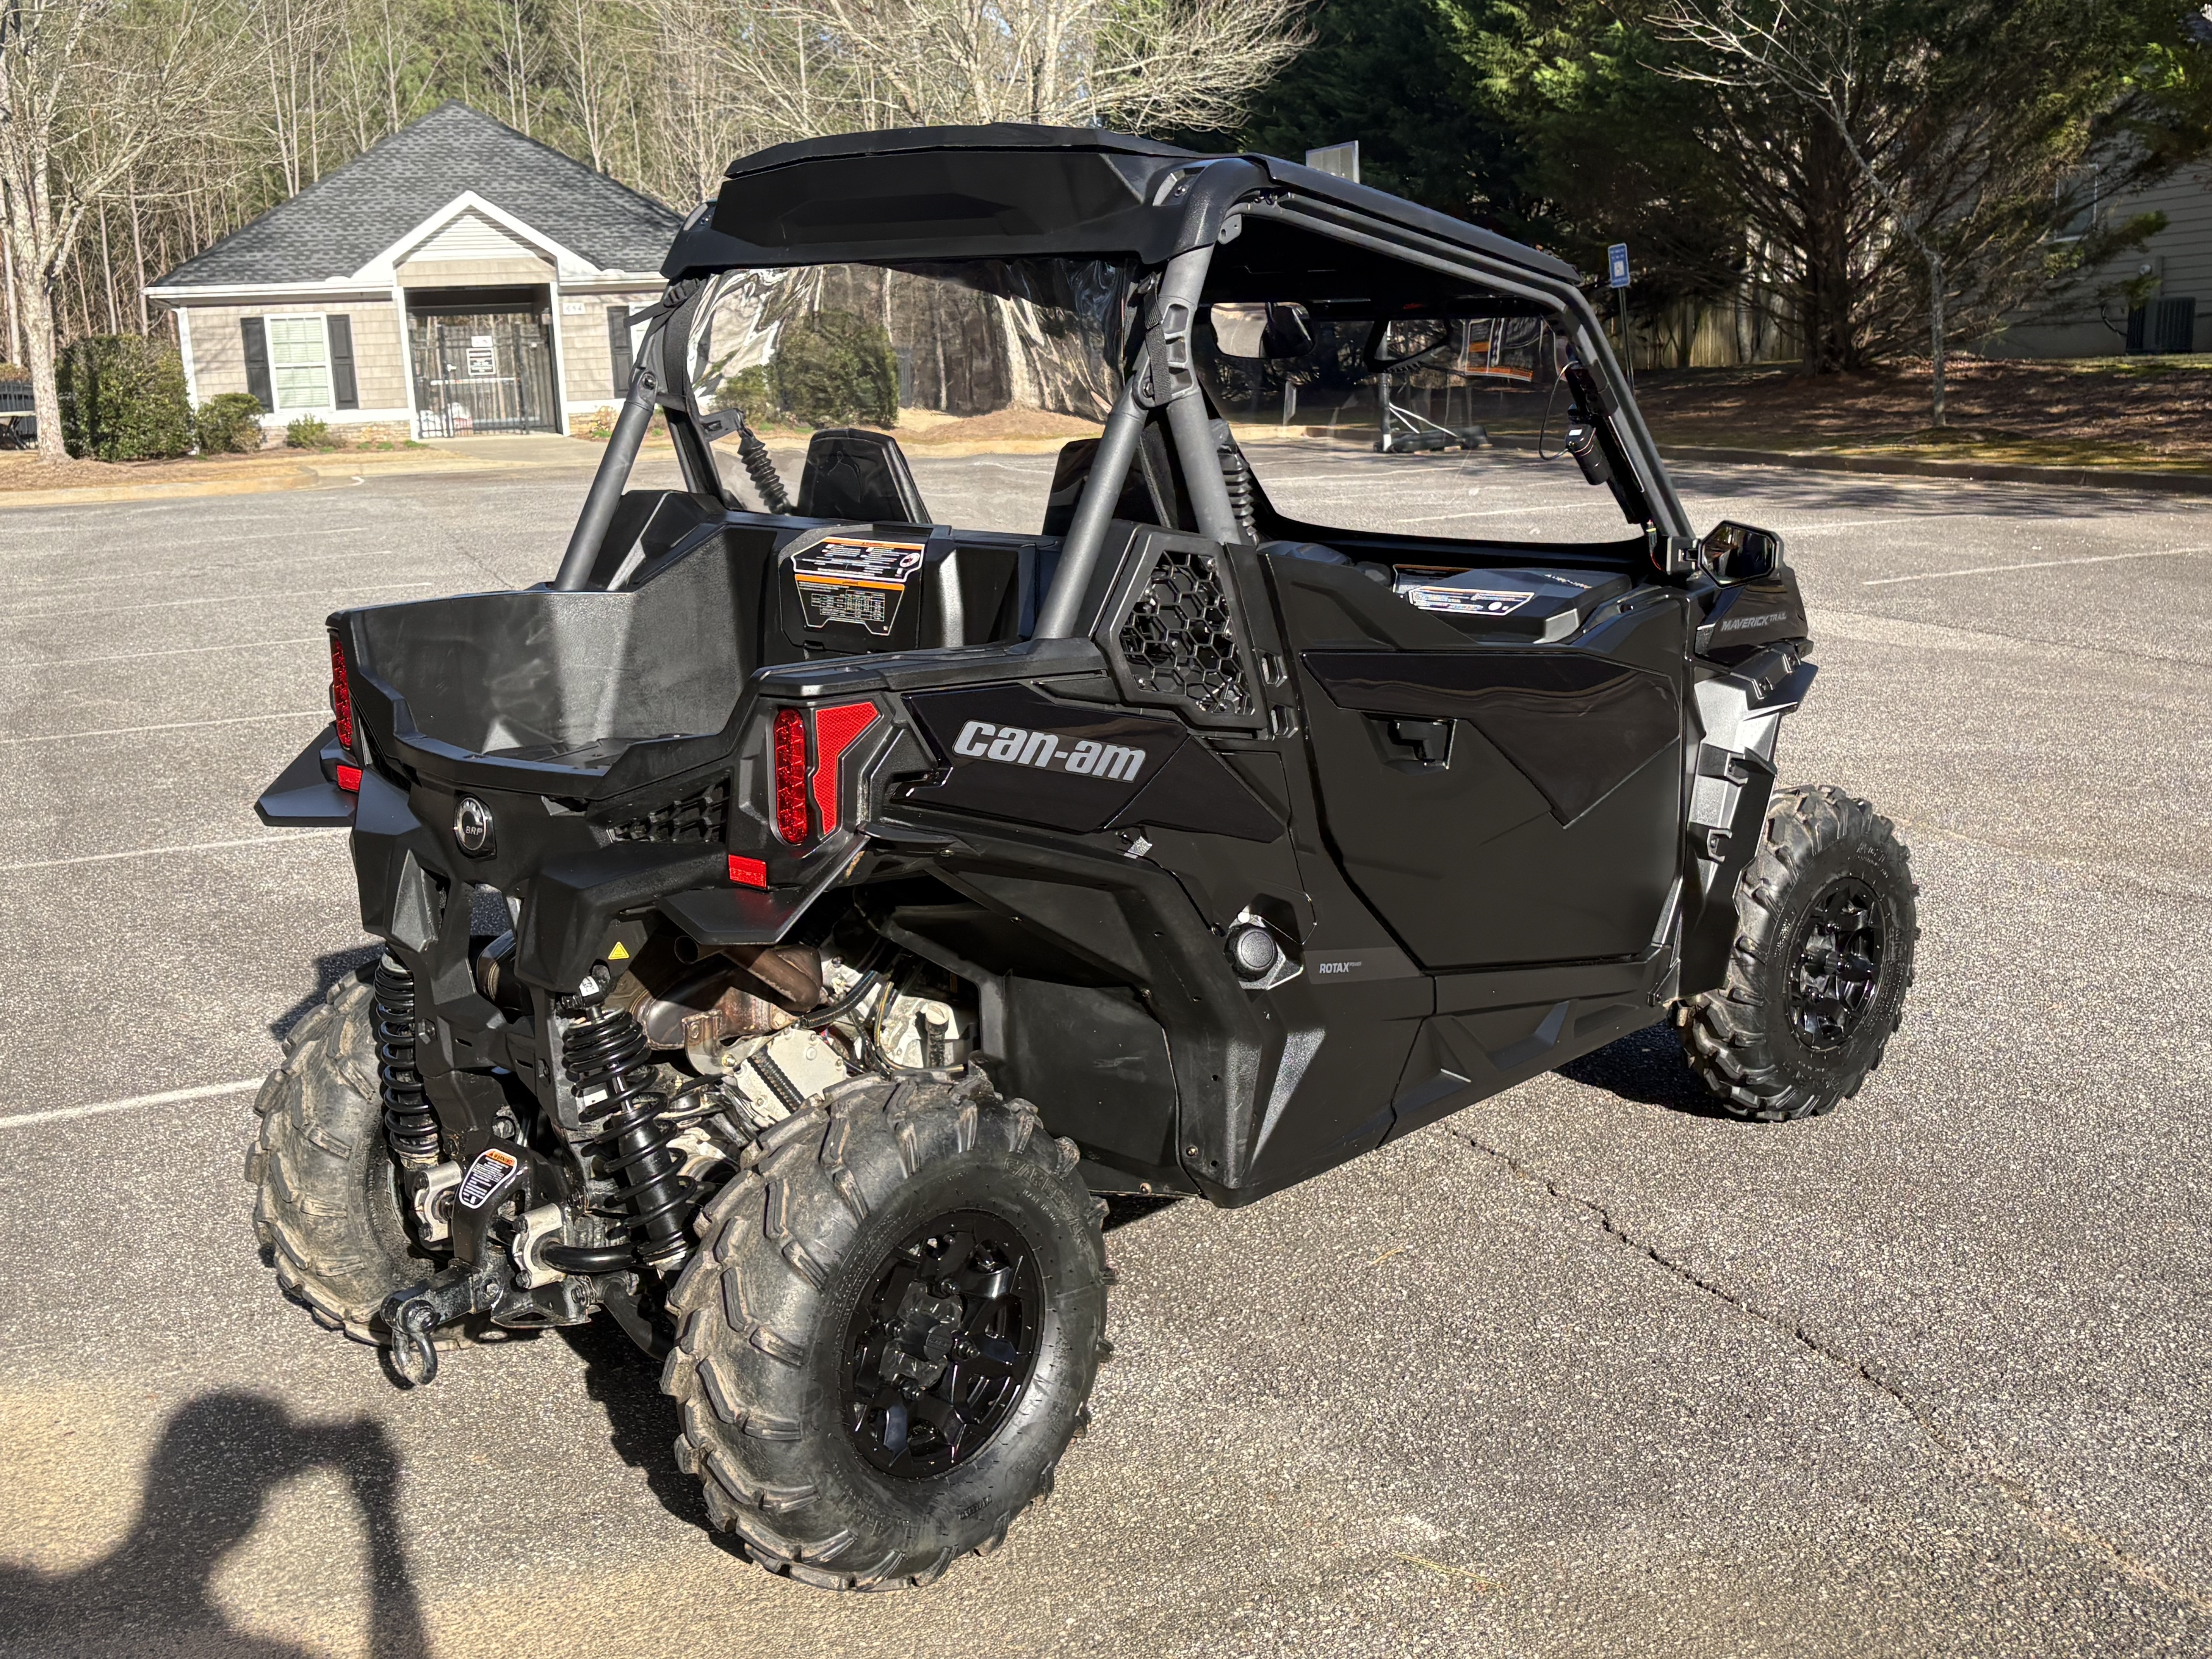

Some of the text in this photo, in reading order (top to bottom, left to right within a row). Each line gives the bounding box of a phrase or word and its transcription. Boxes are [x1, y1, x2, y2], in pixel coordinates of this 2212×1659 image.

[1720, 613, 1786, 631] MAVERICK TRAIL
[954, 721, 1146, 781] can-am
[465, 826, 483, 835] BRP
[1319, 962, 1349, 974] ROTAX
